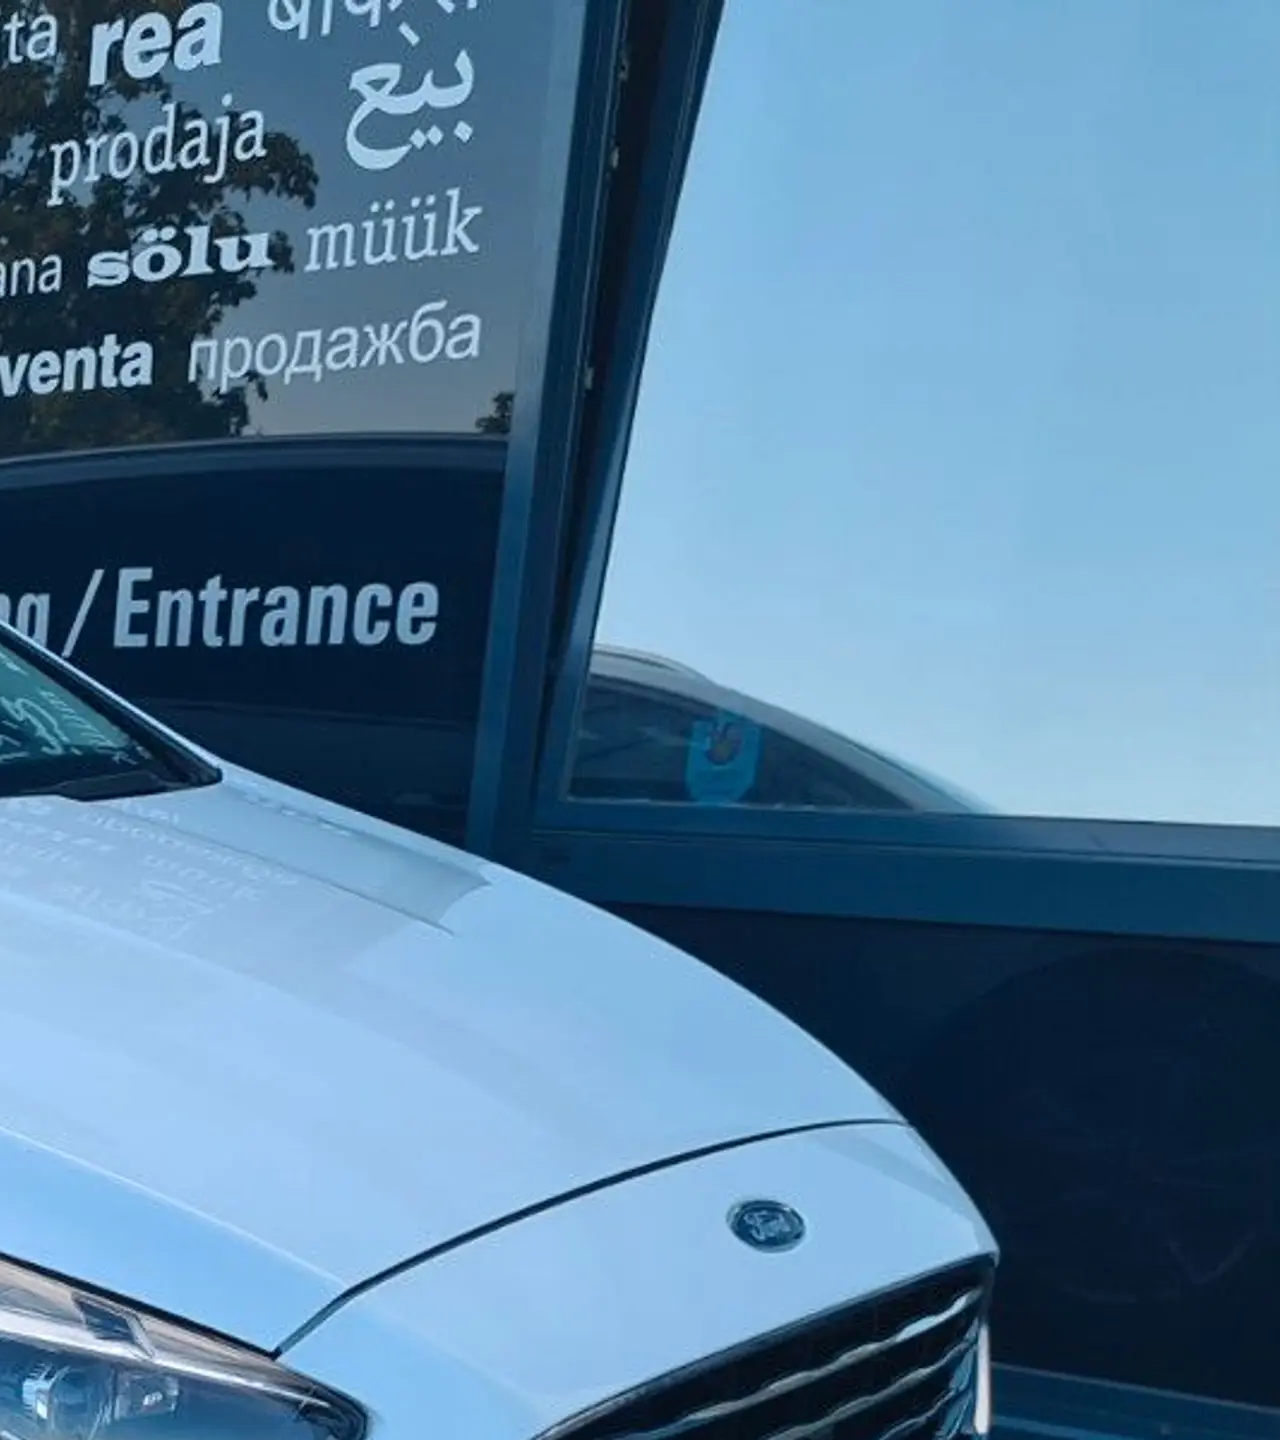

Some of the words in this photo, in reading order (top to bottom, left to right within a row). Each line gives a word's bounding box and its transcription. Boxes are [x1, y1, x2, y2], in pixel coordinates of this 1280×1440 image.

[89, 2, 224, 86] rea
[45, 93, 267, 207] prodaja
[86, 225, 275, 289] sölu
[303, 187, 483, 273] müük
[188, 299, 482, 394] продажба
[113, 567, 440, 650] Entrance
